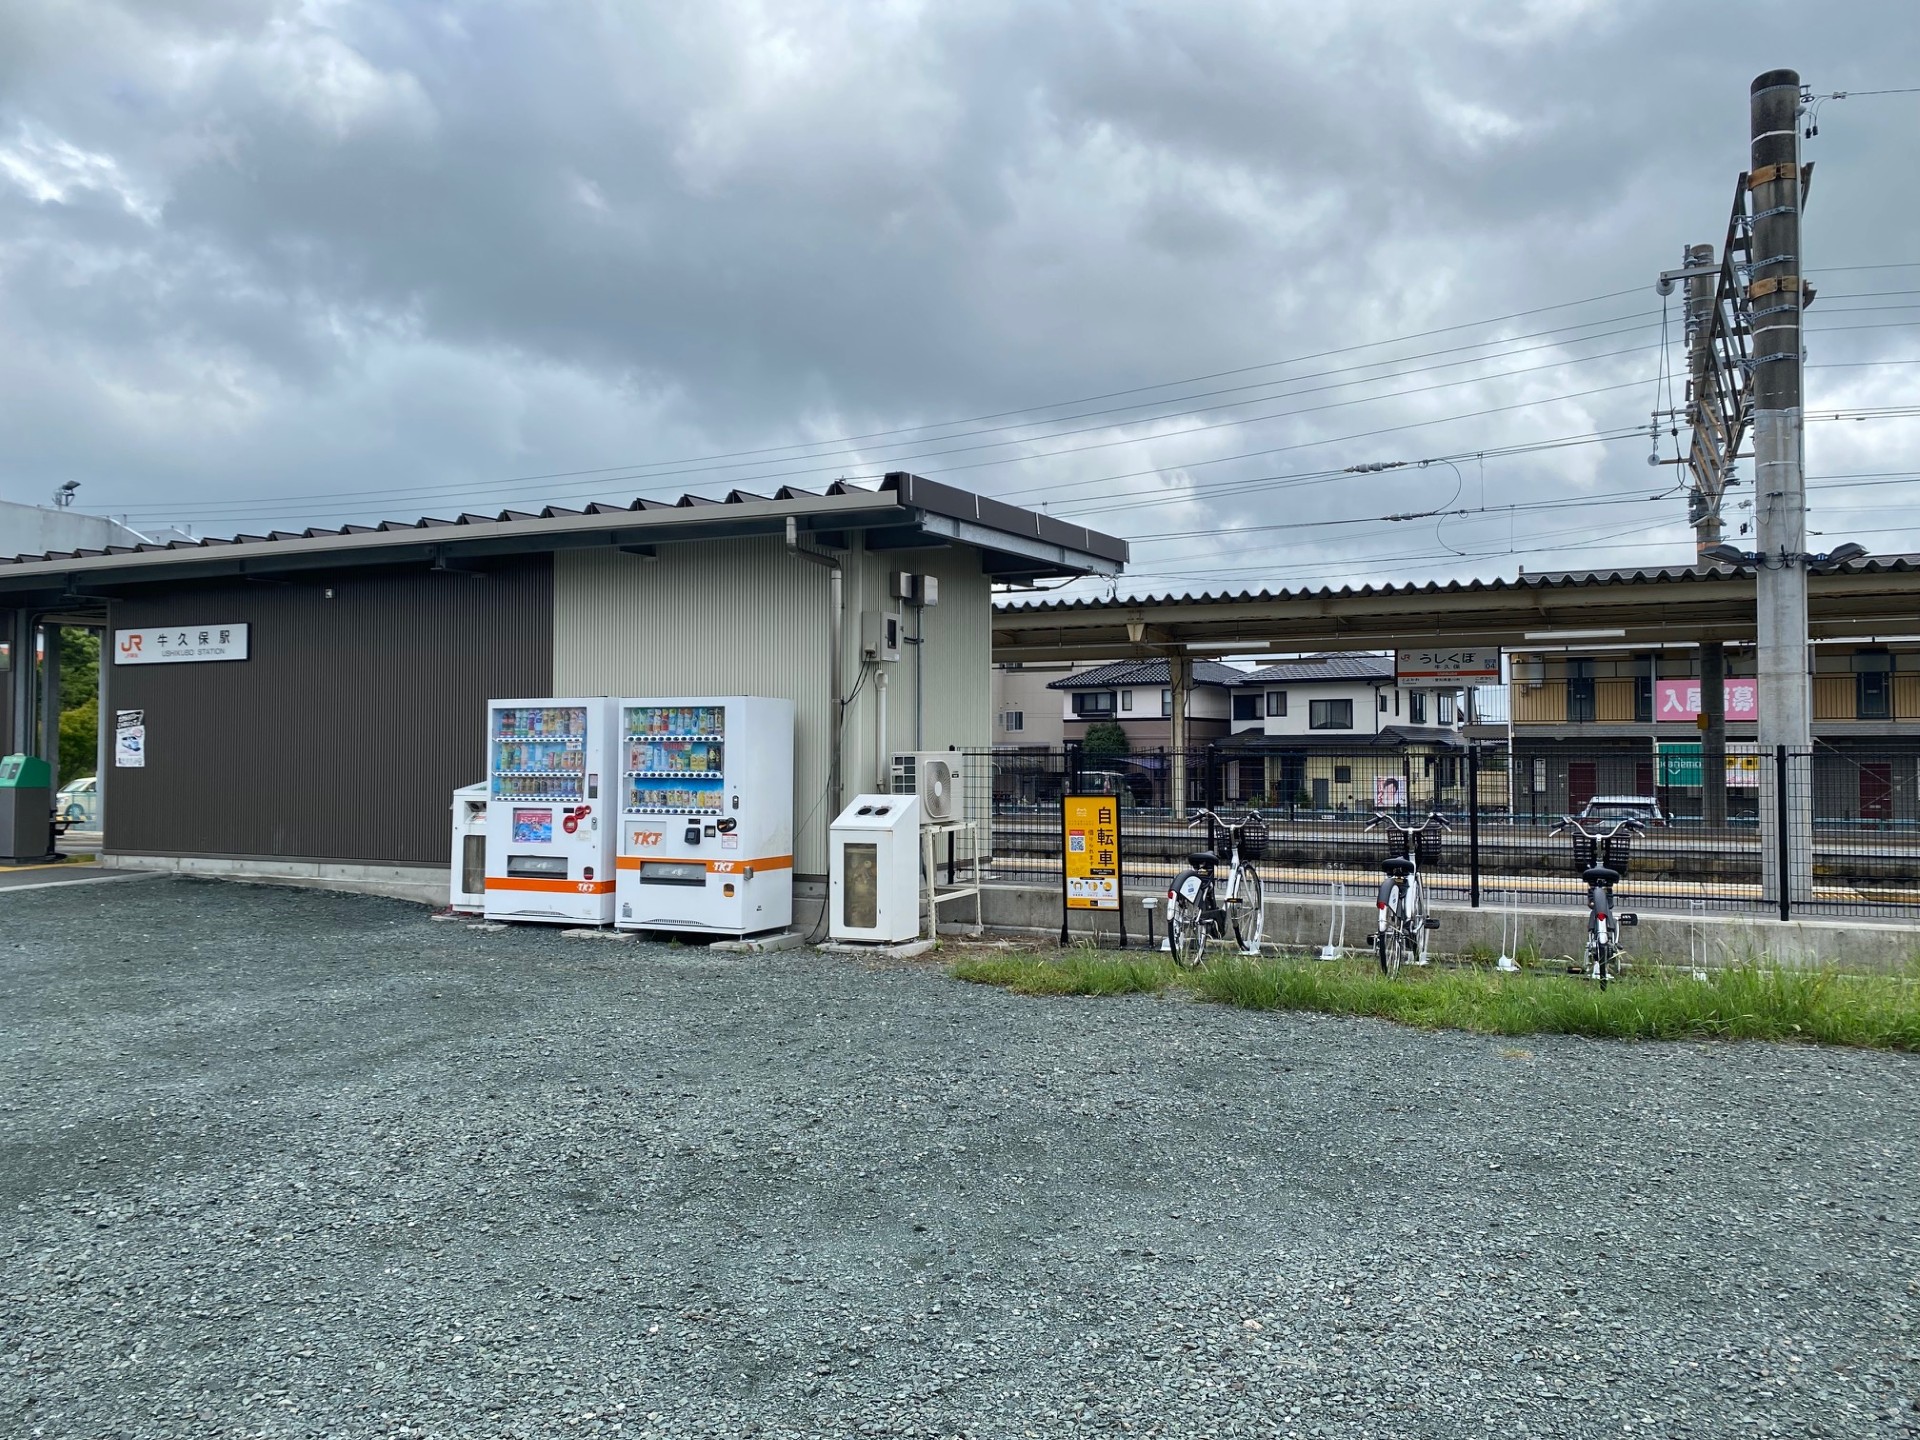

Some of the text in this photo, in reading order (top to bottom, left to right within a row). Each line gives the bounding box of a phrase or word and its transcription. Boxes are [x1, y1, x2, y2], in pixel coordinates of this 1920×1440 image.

[121, 635, 143, 652] JR
[157, 629, 231, 647] 牛久保駅
[162, 648, 225, 657] USHIKUBO STATION
[1420, 653, 1476, 664] うしくぼ
[1663, 686, 1754, 712] 入居募
[1097, 807, 1114, 867] 自転車
